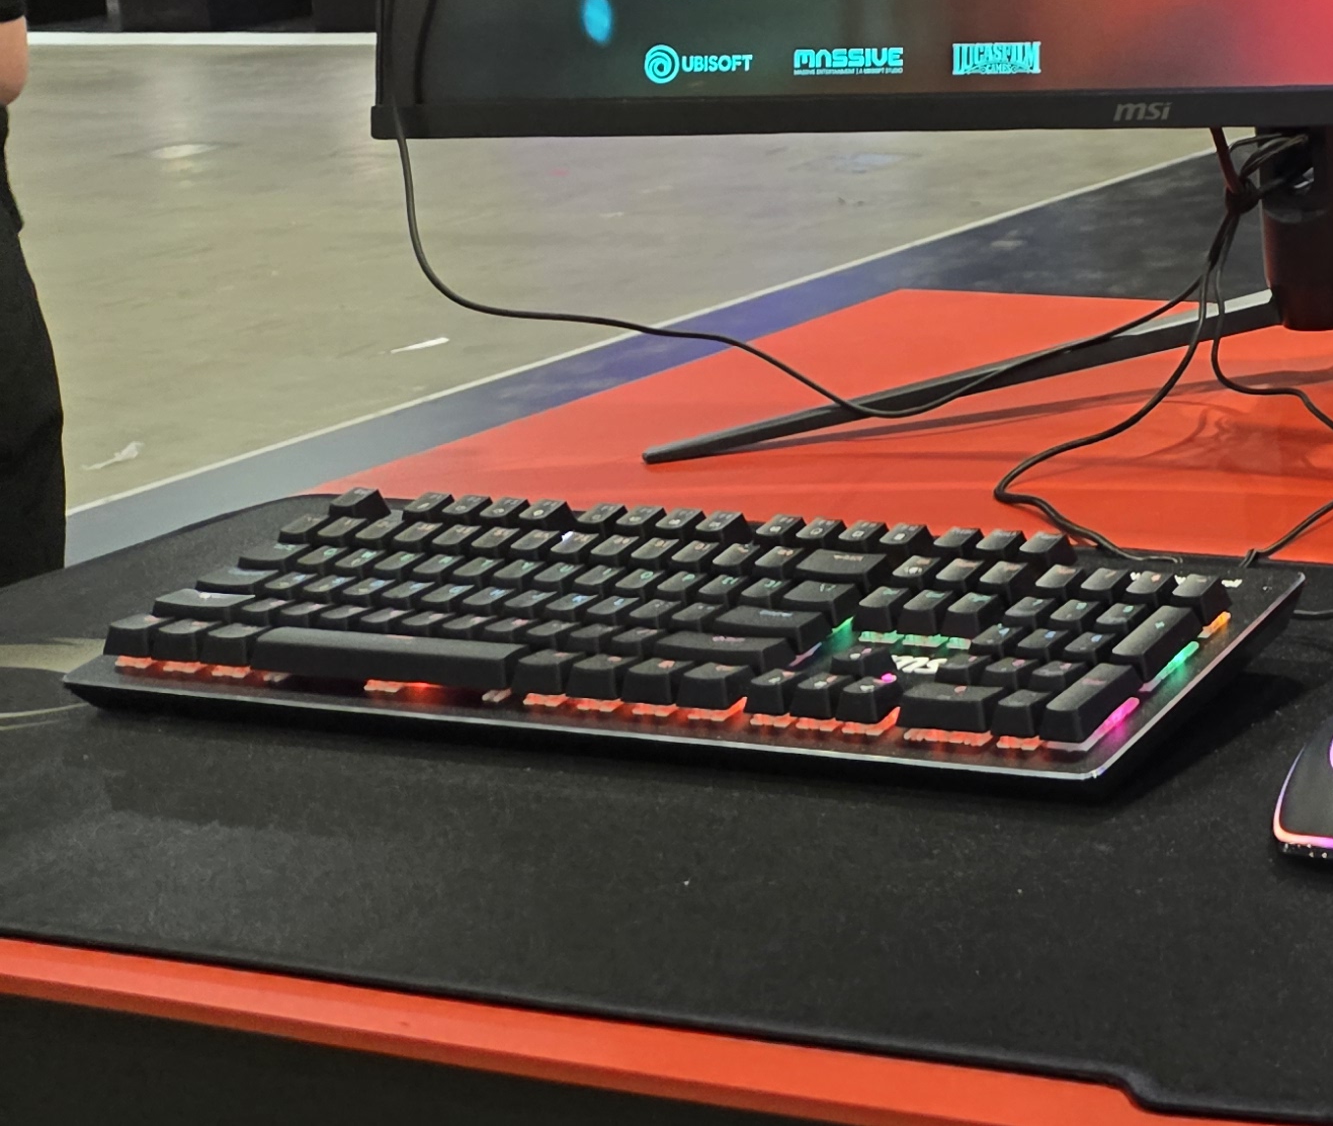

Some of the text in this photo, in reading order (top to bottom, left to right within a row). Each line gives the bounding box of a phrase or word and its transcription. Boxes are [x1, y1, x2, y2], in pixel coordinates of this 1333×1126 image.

[682, 54, 752, 72] UBISOFT
[952, 41, 1041, 75] LUCASFILM
[1113, 101, 1172, 122] msi
[891, 654, 947, 673] ms
